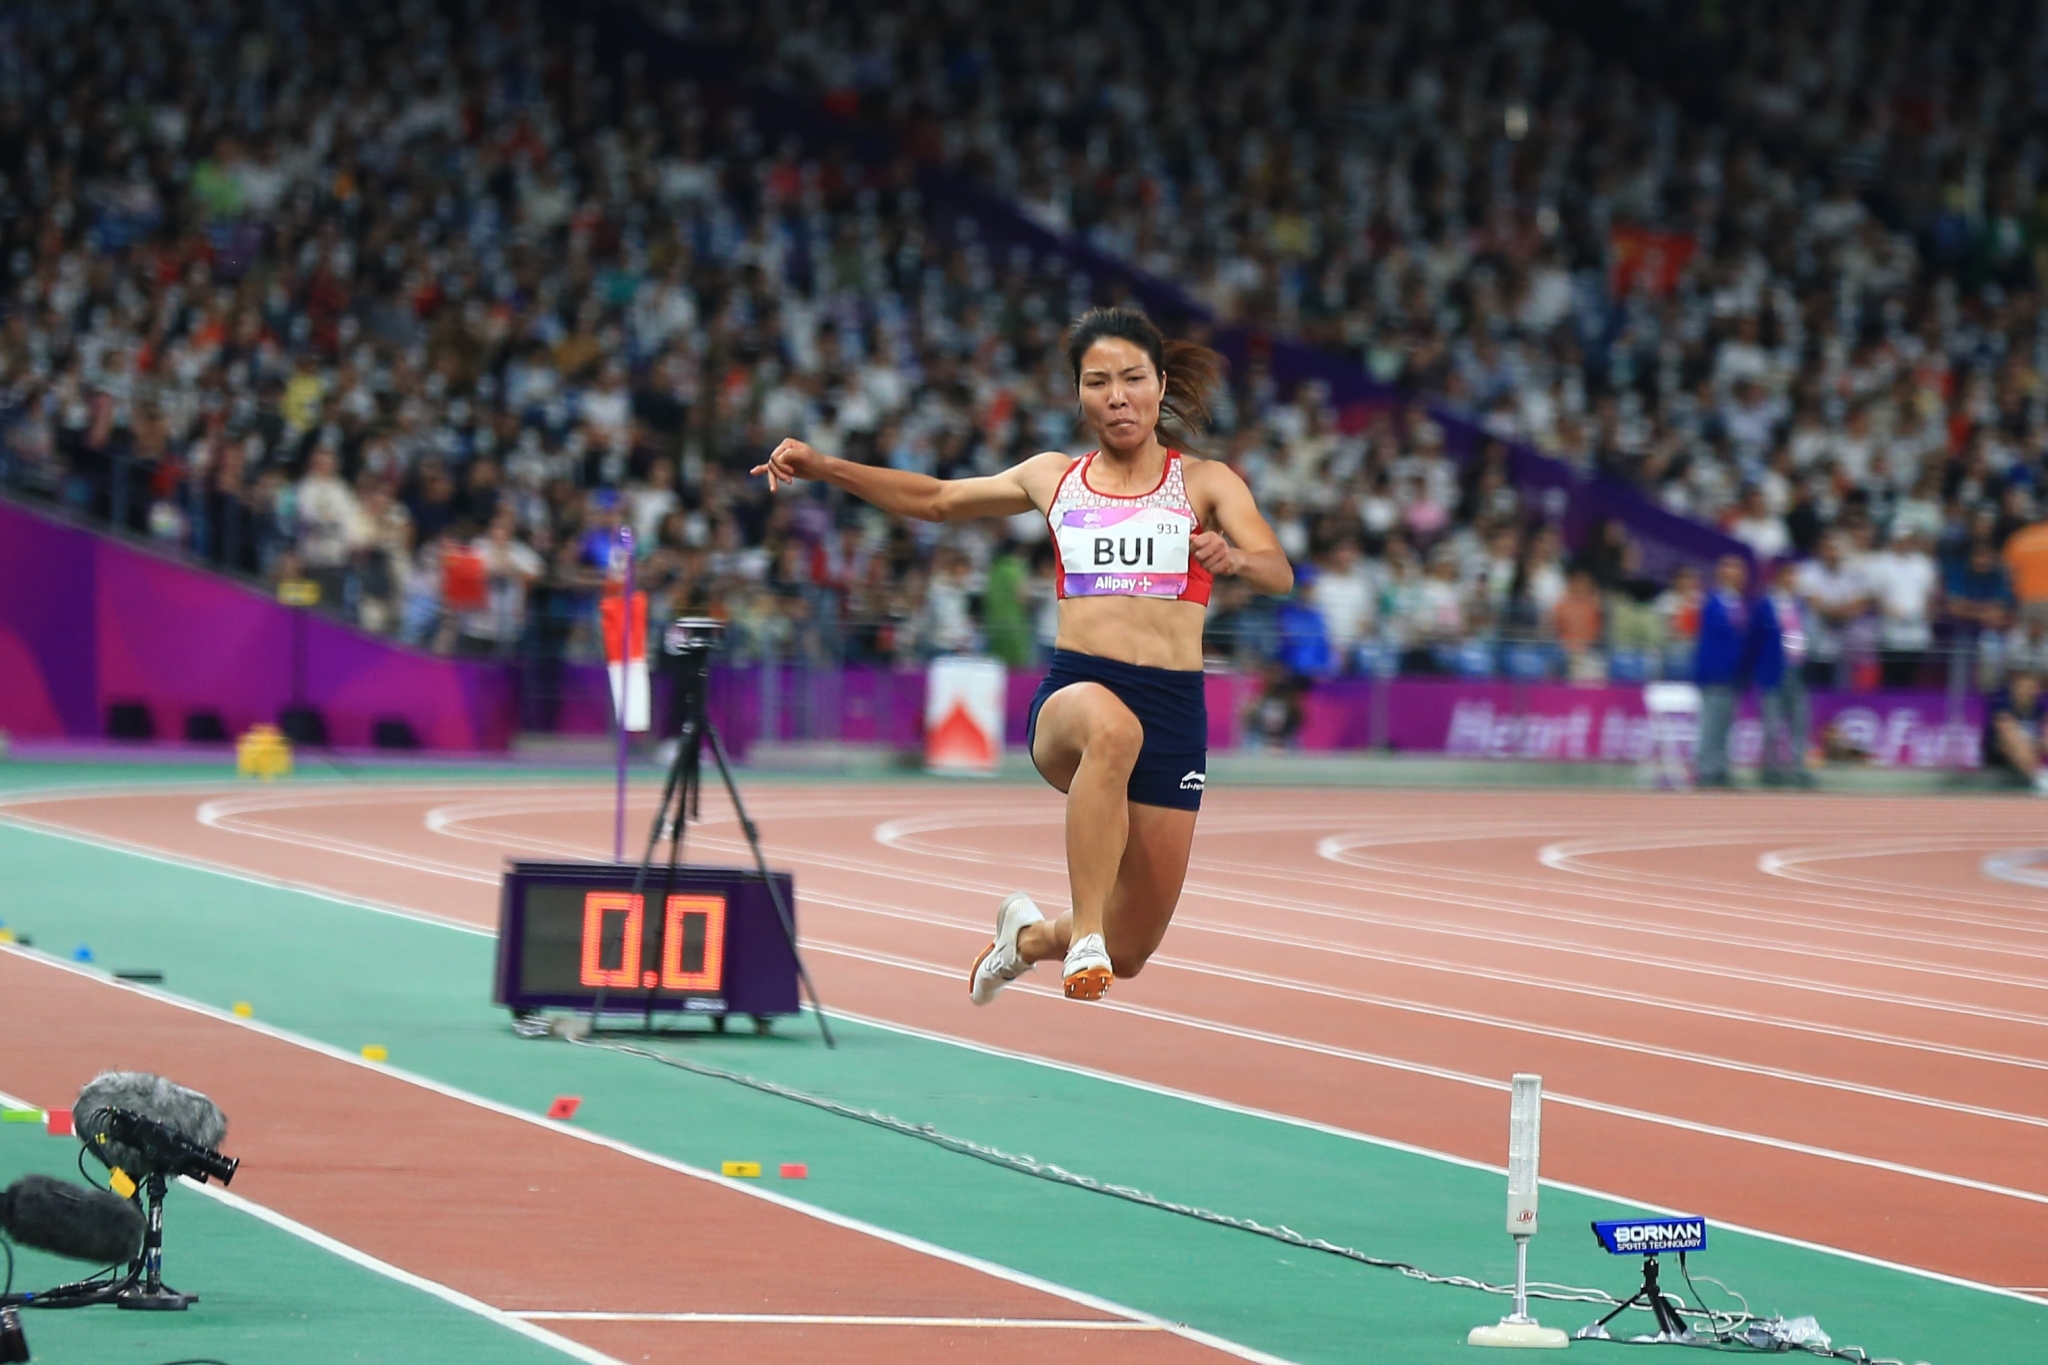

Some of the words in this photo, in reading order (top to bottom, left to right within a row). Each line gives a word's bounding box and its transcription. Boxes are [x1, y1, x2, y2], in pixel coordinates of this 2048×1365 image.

[1157, 523, 1180, 535] 931
[1094, 537, 1153, 566] BUI
[581, 891, 727, 990] 0.0
[1614, 1221, 1702, 1243] BORNAN
[1617, 1241, 1647, 1251] SPORTS
[1650, 1238, 1702, 1249] TECHNOLOGY
